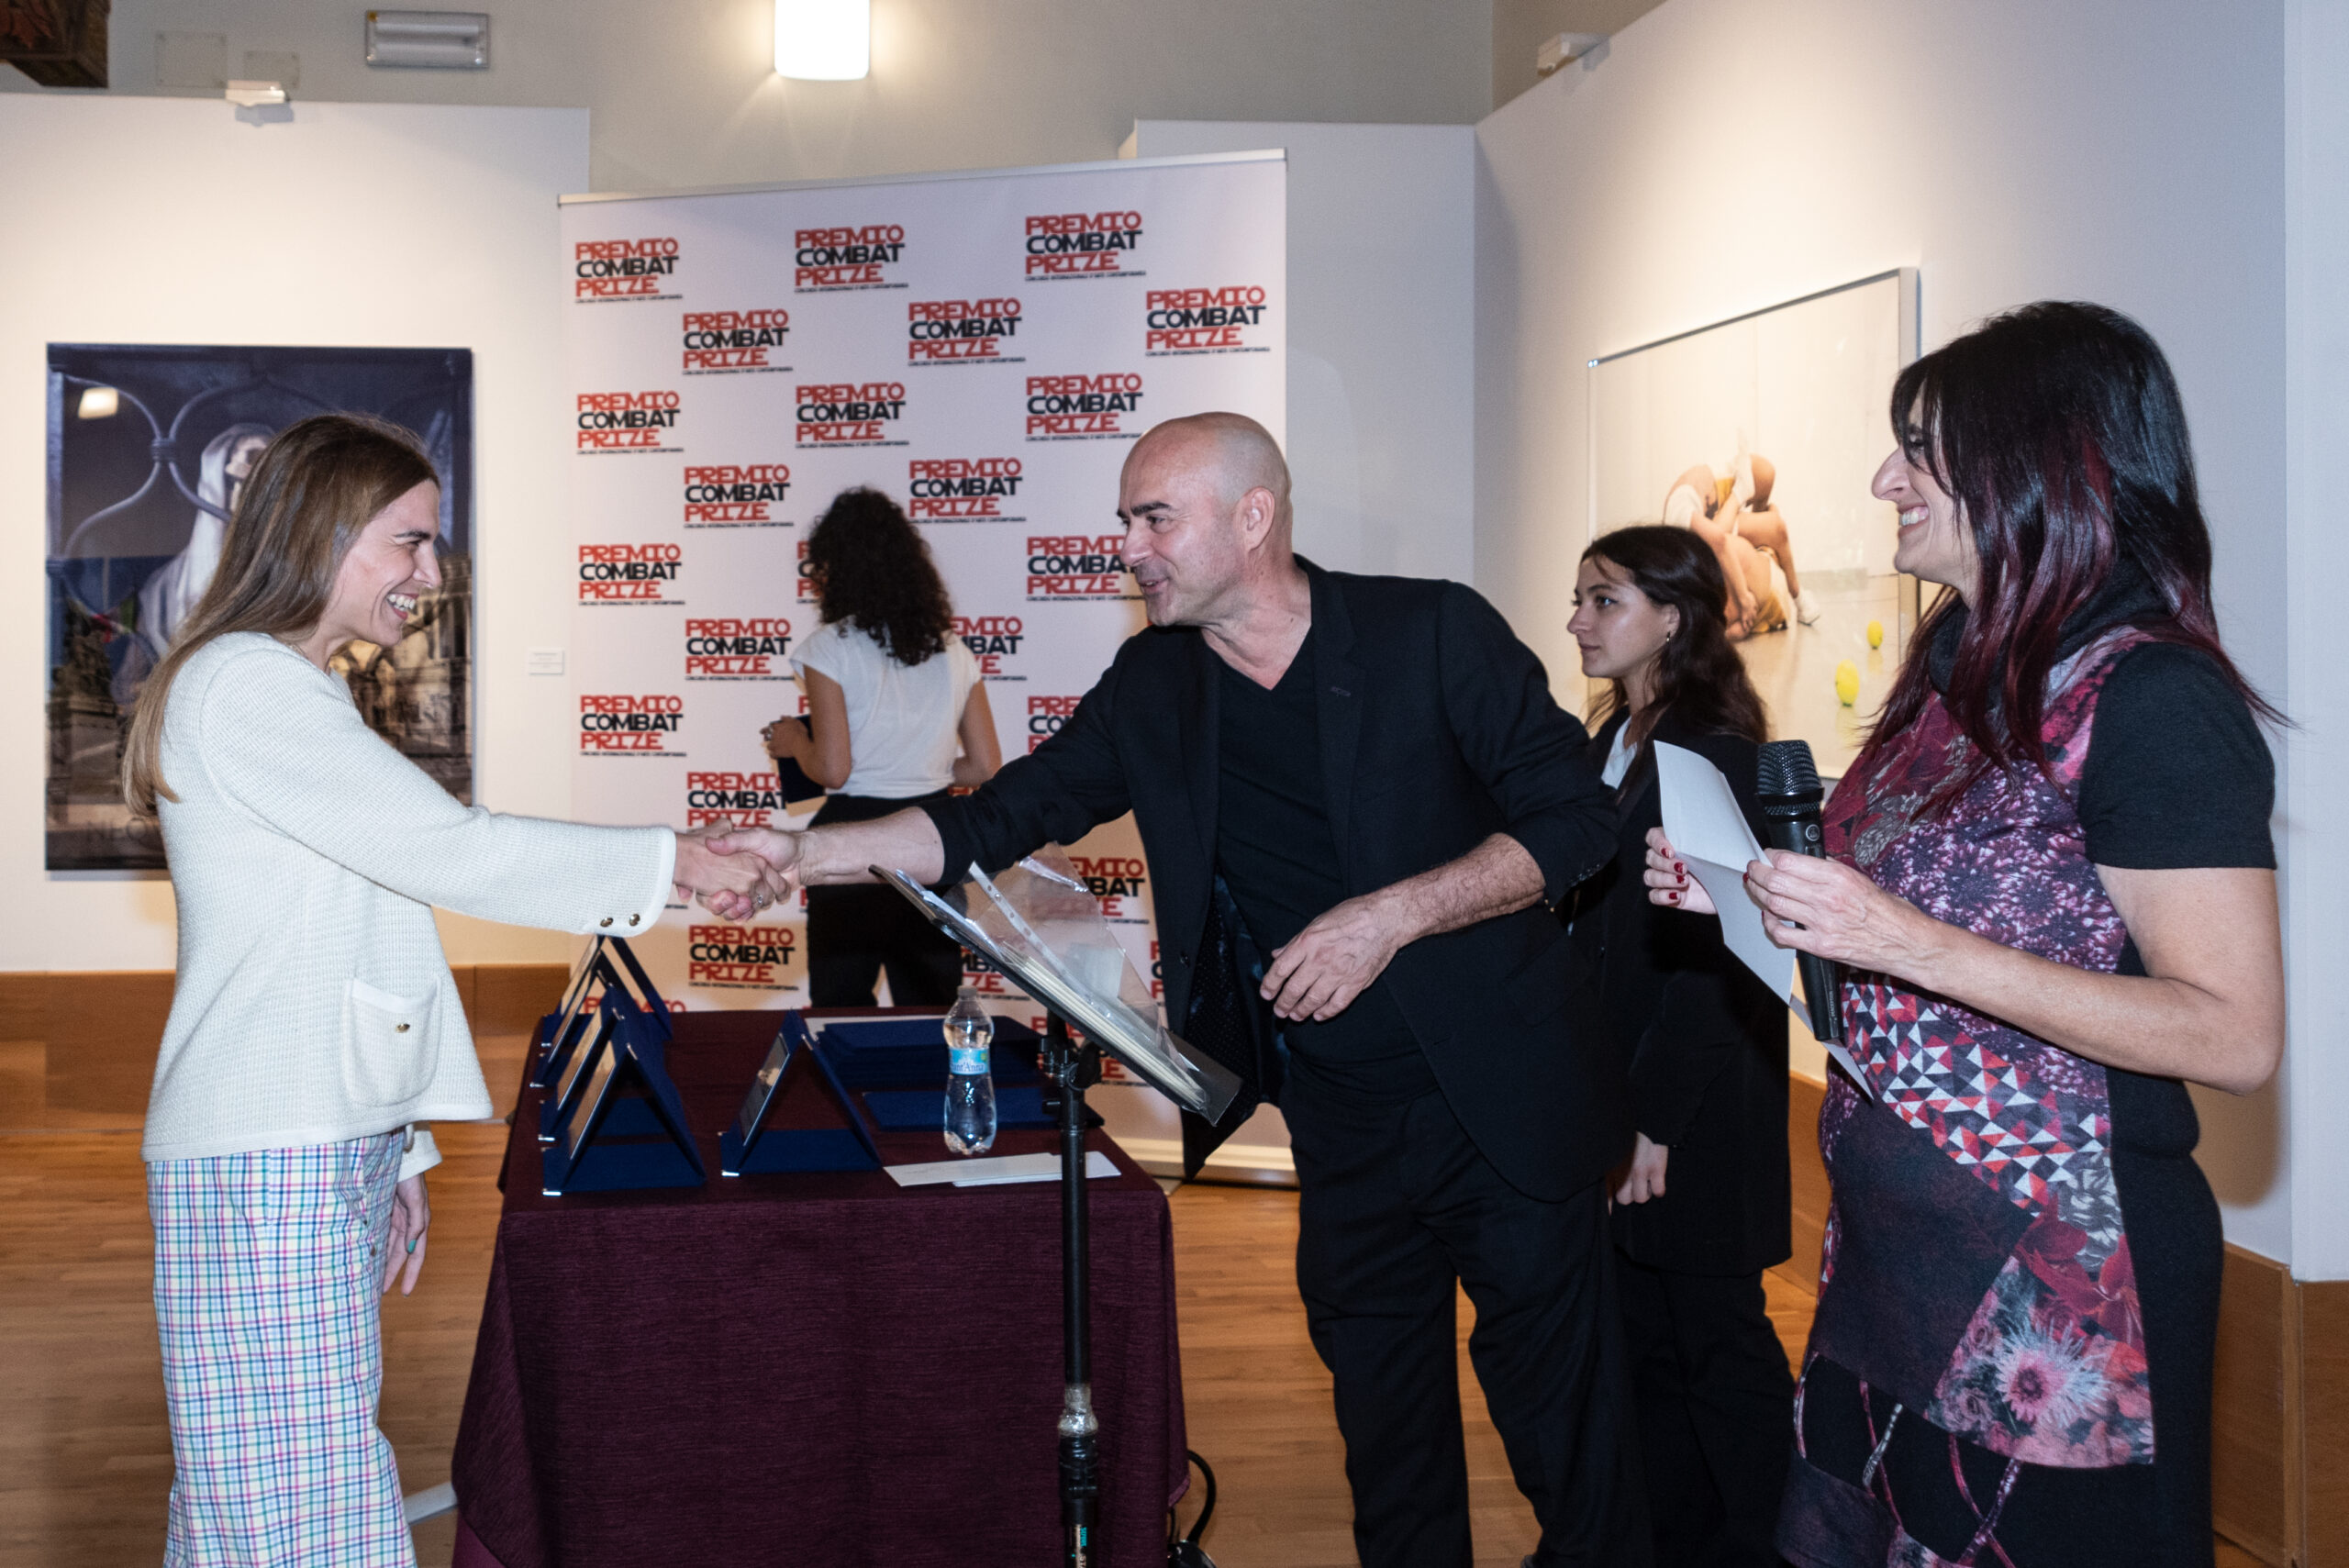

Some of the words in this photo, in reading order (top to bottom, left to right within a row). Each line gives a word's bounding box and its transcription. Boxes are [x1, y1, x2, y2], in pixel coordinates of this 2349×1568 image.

[1025, 211, 1142, 236] PREMIO
[796, 225, 905, 249] PREMIO
[1026, 229, 1143, 255] COMBAT
[575, 237, 679, 261] PREMIO
[796, 242, 906, 268] COMBAT
[576, 255, 679, 278] COMBAT
[1026, 250, 1119, 274] PRIZE
[576, 274, 660, 297] PRIZE
[795, 263, 883, 287] PRIZE
[1146, 286, 1265, 310] PREMIO
[908, 298, 1021, 321] PREMIO
[1147, 306, 1266, 329] COMBAT
[683, 309, 789, 333] PREMIO
[909, 316, 1022, 340] COMBAT
[684, 327, 790, 350] COMBAT
[908, 337, 999, 360] PRIZE
[1146, 326, 1242, 350] PRIZE
[683, 347, 768, 369] PRIZE
[796, 382, 906, 405] PREMIO
[1026, 373, 1142, 395] PREMIO
[577, 391, 680, 413] PREMIO
[796, 400, 907, 423] COMBAT
[1027, 392, 1143, 416] COMBAT
[578, 408, 681, 429] COMBAT
[1026, 412, 1120, 434] PRIZE
[578, 427, 661, 449] PRIZE
[796, 420, 884, 442] PRIZE
[684, 463, 790, 485] PREMIO
[909, 457, 1022, 480] PREMIO
[685, 482, 791, 503] COMBAT
[909, 476, 1023, 498] COMBAT
[685, 501, 770, 522] PRIZE
[909, 495, 1000, 518] PRIZE
[579, 543, 681, 564] PREMIO
[1027, 535, 1127, 557] PREMI
[580, 562, 682, 581] COMBAT
[1027, 553, 1129, 575] COMBA
[579, 579, 662, 599] PRIZE
[1027, 573, 1121, 595] PRIZE
[685, 617, 791, 639] PREMIO
[949, 615, 1023, 637] EMIO
[686, 636, 792, 656] COMBAT
[960, 634, 1025, 656] BAT
[685, 654, 772, 674] PRIZE
[580, 695, 683, 716] PREMIO
[1027, 695, 1083, 717] PRE
[581, 713, 684, 732] COMBAT
[581, 730, 663, 751] PRIZE
[686, 772, 782, 793] PREMI
[1082, 875, 1146, 898] BAT
[688, 924, 795, 946] PREMIO
[689, 942, 796, 965] COMBAT
[688, 962, 775, 984] PRIZE
